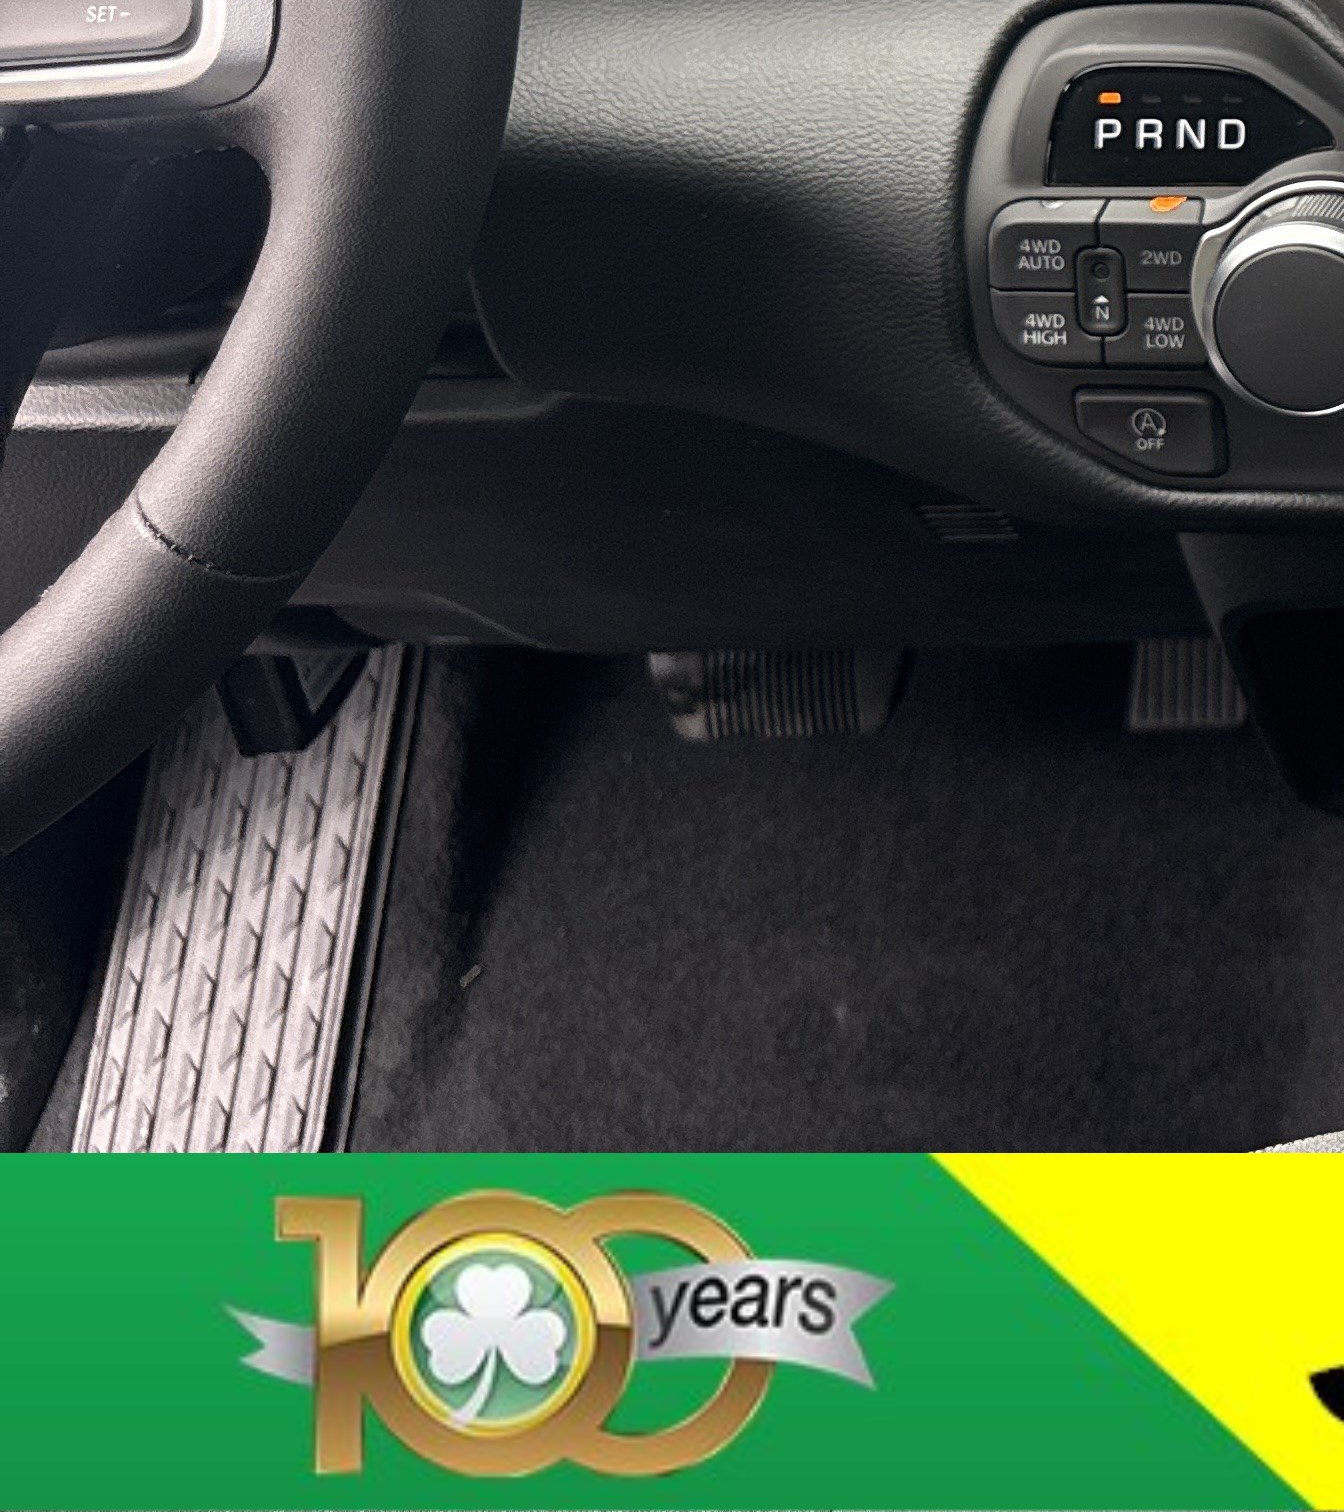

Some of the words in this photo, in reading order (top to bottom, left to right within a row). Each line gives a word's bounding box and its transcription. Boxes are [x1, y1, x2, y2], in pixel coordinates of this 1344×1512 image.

[1018, 238, 1062, 255] 4WD
[1017, 254, 1065, 272] AUTO
[1139, 249, 1182, 266] 2WD
[1024, 313, 1065, 330] 4WD
[1144, 315, 1185, 332] 4WD
[1022, 328, 1067, 347] HIGH
[1145, 331, 1185, 349] LOW
[1136, 437, 1165, 451] OFF
